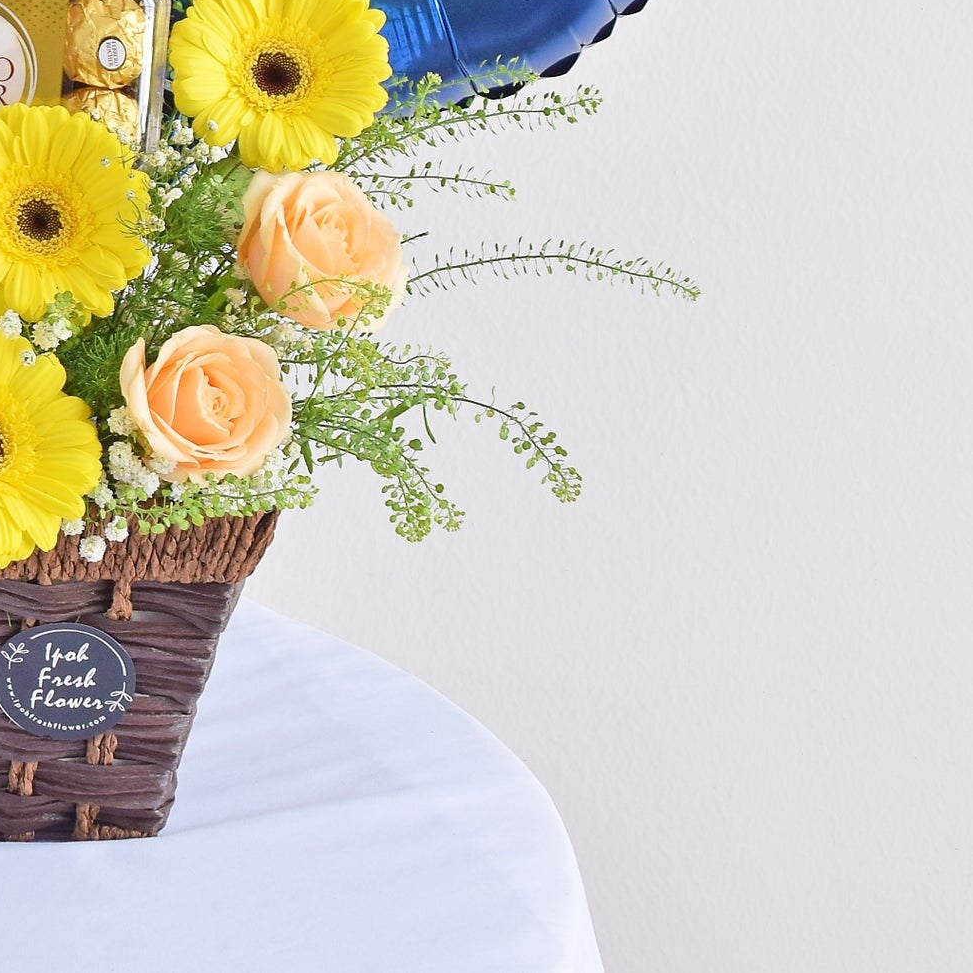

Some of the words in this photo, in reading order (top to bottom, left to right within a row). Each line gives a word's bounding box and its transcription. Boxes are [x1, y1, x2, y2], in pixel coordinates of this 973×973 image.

[45, 642, 90, 668] Ipoh
[38, 667, 97, 689] Fresh
[30, 689, 104, 710] Flower
